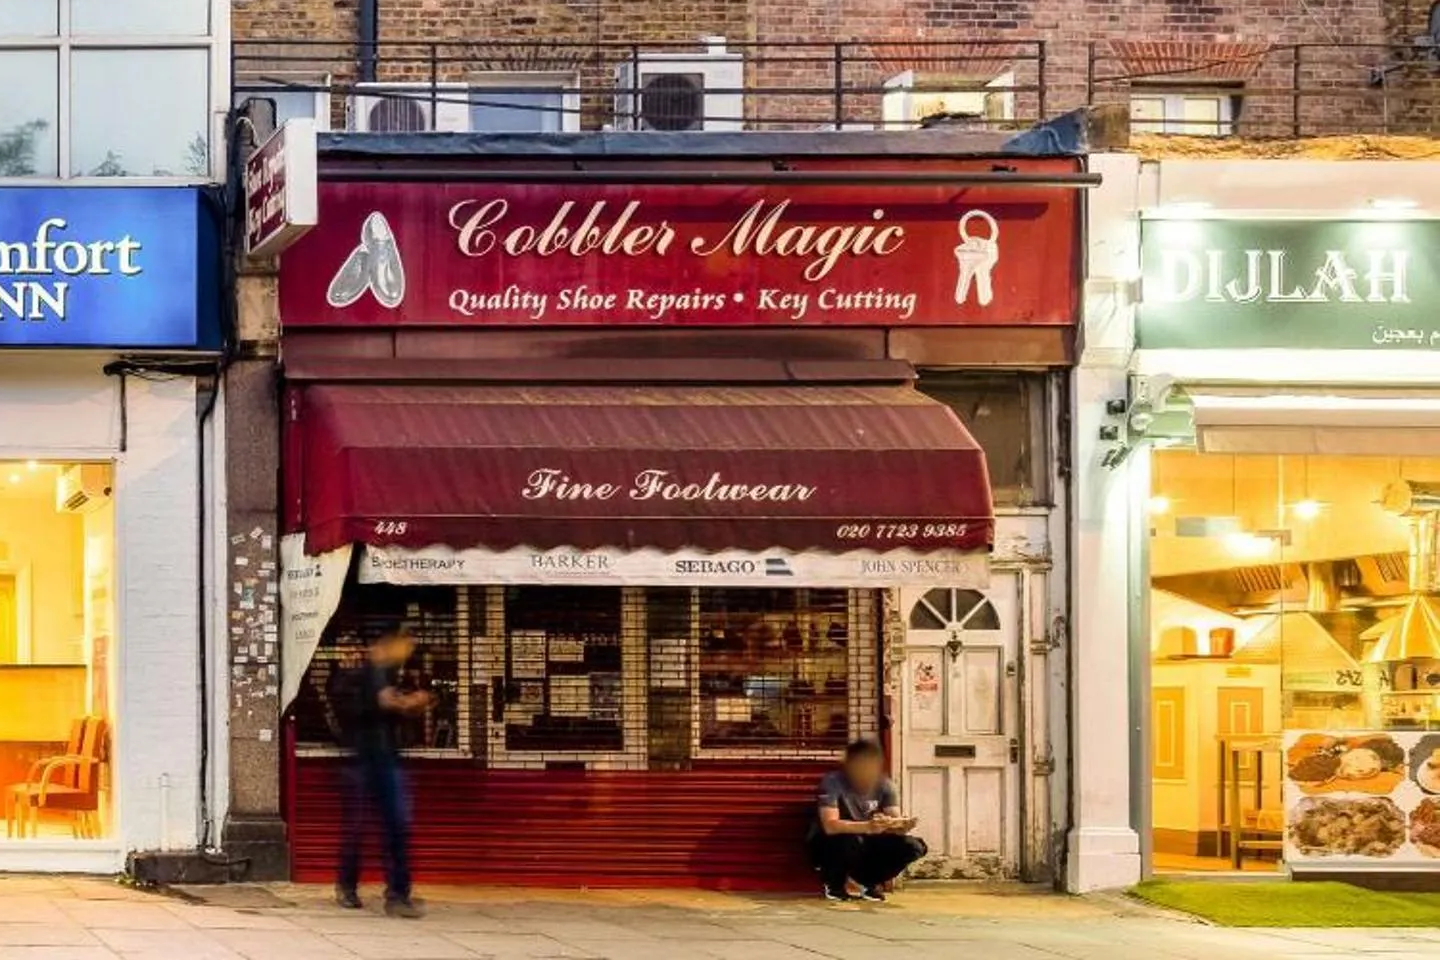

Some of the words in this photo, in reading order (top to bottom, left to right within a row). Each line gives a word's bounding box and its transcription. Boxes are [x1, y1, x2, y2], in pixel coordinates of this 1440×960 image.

[448, 198, 676, 257] Cobbler
[691, 198, 906, 282] Magic
[1160, 248, 1412, 304] DIJLAH
[448, 285, 548, 319] Quality
[556, 287, 617, 311] Shoe
[626, 287, 726, 319] Repairs
[758, 287, 809, 320] Key
[817, 288, 917, 320] Cutting
[521, 468, 621, 501] Fine
[628, 469, 817, 501] Footwear
[374, 520, 408, 535] 448
[836, 524, 871, 539] 020
[876, 524, 919, 539] 7723
[922, 524, 968, 538] 9385
[674, 559, 756, 574] SEBAGO
